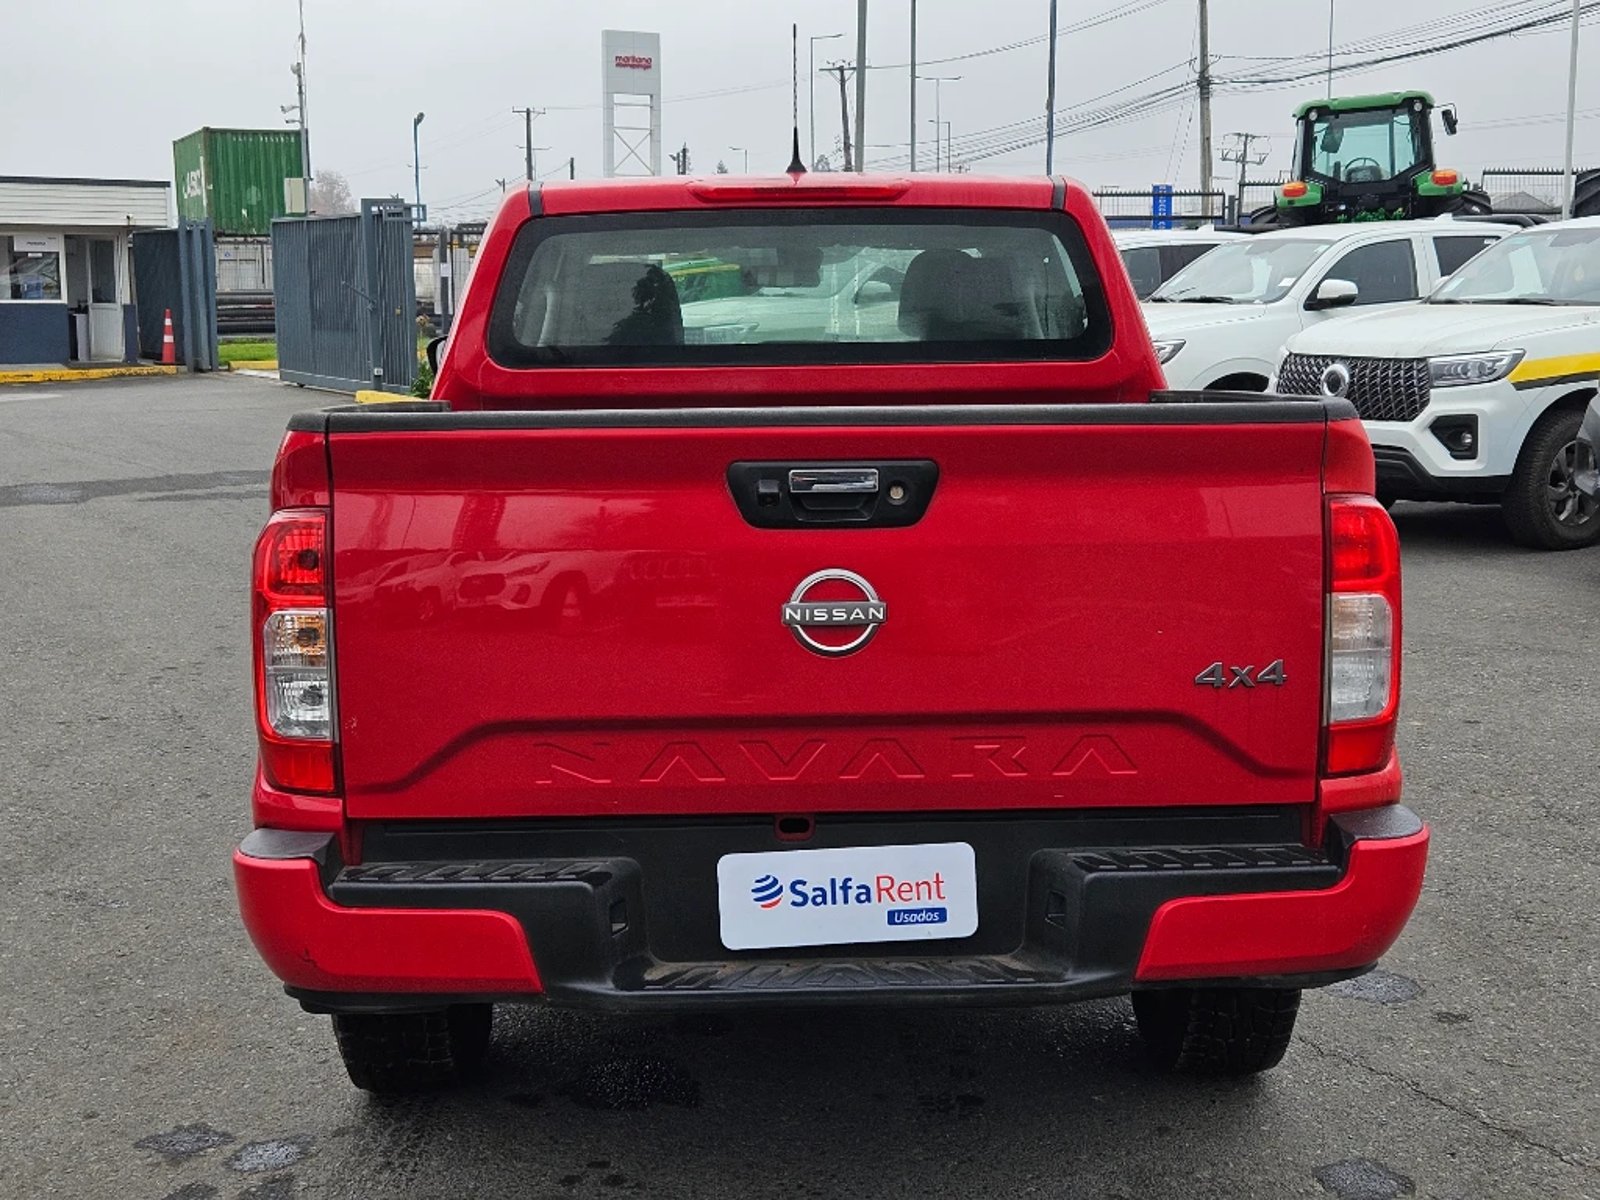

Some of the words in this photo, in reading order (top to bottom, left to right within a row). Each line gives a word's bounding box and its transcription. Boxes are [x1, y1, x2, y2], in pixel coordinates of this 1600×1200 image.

[785, 607, 884, 621] NISSAN
[1195, 659, 1288, 688] 4x4
[534, 734, 1138, 784] NAVARA
[894, 910, 940, 924] Usados
